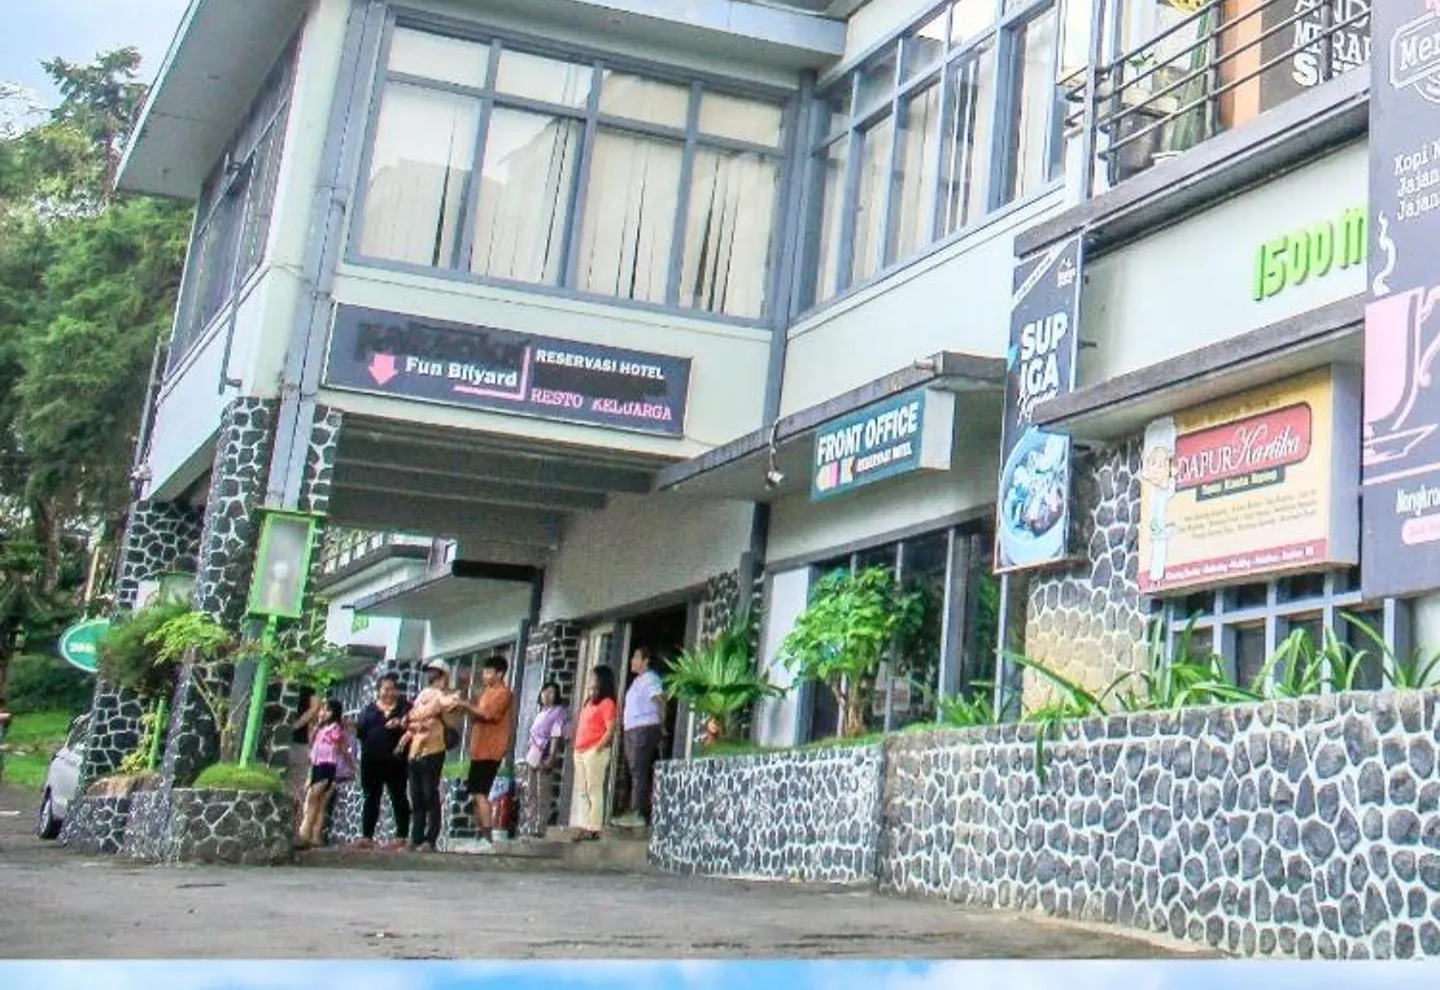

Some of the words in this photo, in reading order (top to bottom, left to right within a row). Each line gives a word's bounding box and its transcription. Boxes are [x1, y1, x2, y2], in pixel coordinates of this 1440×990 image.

[1394, 149, 1428, 176] Kopi
[1254, 220, 1334, 302] 1500
[1020, 311, 1069, 361] SUP
[404, 354, 443, 378] Fun
[447, 361, 519, 387] Bilyard
[534, 348, 616, 375] RESERVASI
[618, 360, 665, 380] HOTEL
[1019, 353, 1061, 395] IGA
[529, 386, 584, 409] RESTO
[590, 395, 673, 422] KELUARGA
[817, 422, 865, 466] FRONT
[865, 401, 920, 450] OFFICE
[1177, 445, 1234, 483] DAPUR
[1232, 424, 1301, 471] Kartika
